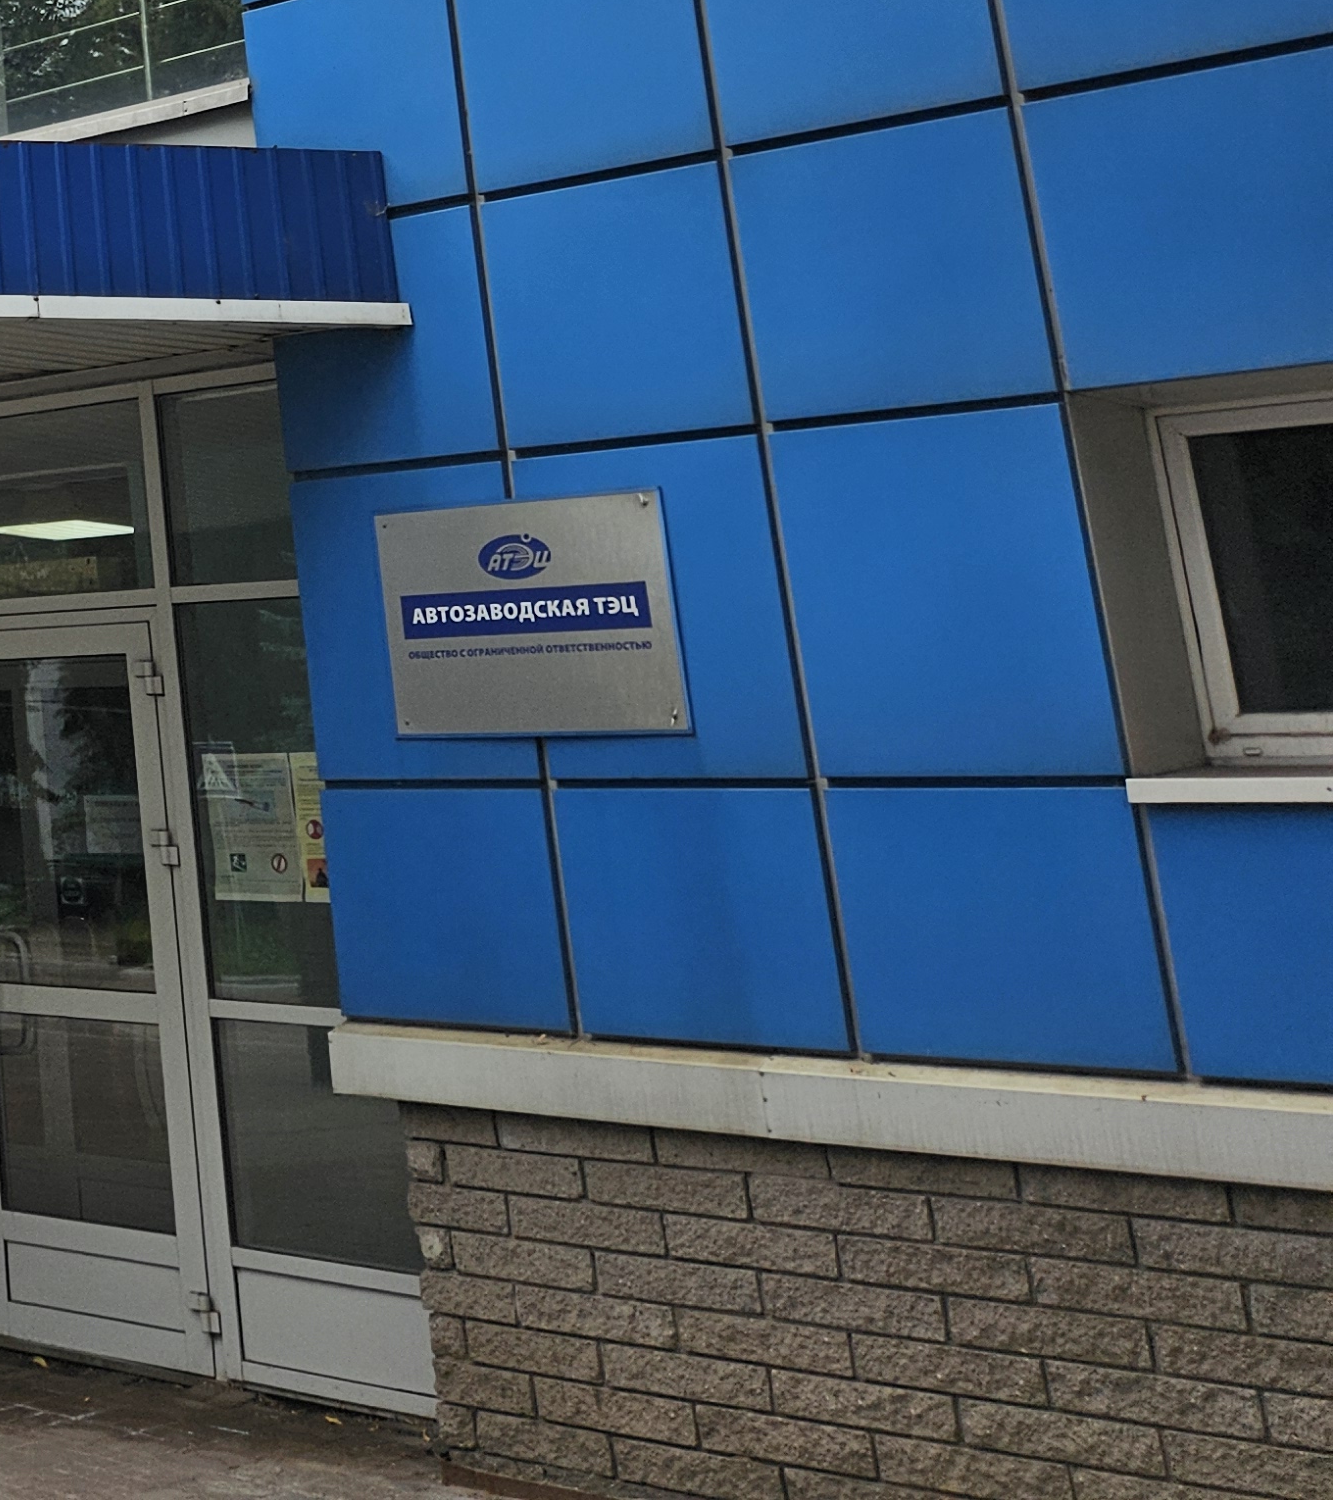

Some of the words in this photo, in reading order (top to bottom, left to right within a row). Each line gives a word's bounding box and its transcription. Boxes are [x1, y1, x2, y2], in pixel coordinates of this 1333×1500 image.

[412, 598, 590, 624] АВТОЗАВОДСКАЯ
[593, 596, 639, 617] ТЭЦ
[408, 649, 457, 660] ОБЩЕСТВО
[459, 649, 465, 658] С
[467, 644, 544, 657] ОГРАНИЧЕННОЙ
[546, 641, 652, 654] ОТВЕТСТВЕННОСТЬЮ
